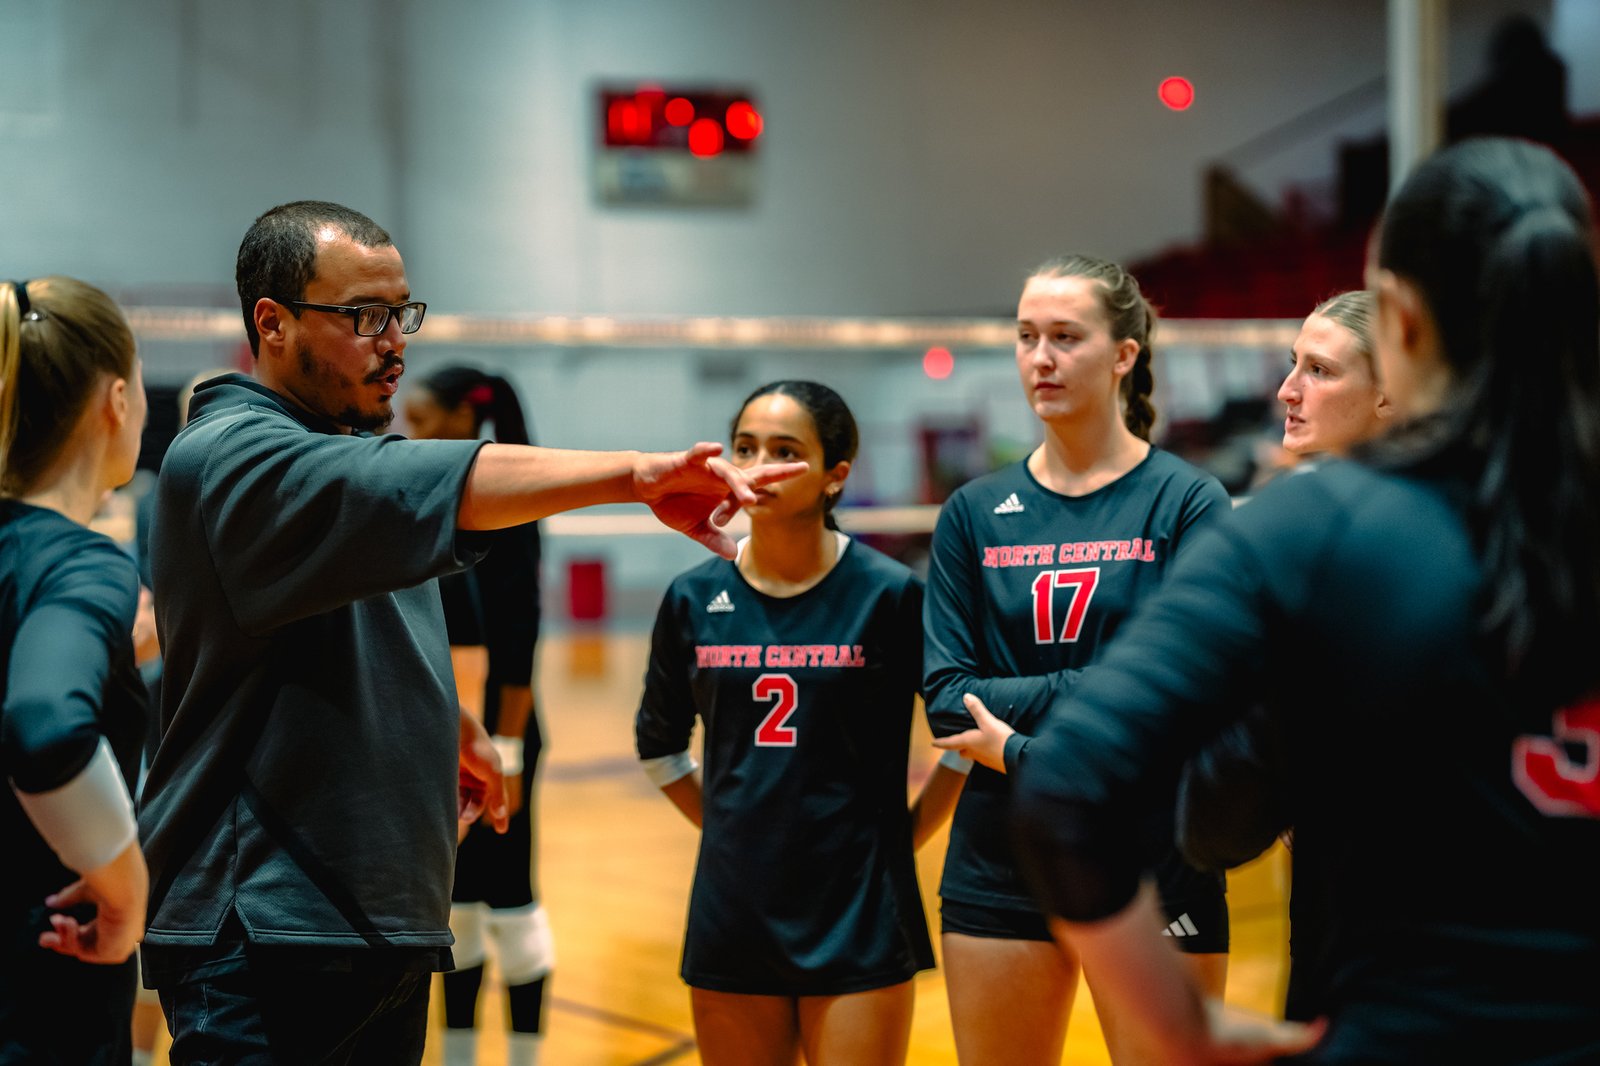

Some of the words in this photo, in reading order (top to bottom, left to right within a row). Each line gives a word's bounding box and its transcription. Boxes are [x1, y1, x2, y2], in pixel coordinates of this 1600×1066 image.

[982, 544, 1056, 568] NORTH
[1058, 537, 1155, 564] CENTRAL
[1031, 567, 1100, 645] 17
[695, 645, 763, 668] NORTH
[765, 645, 865, 668] CENTRAL
[752, 673, 798, 747] 2
